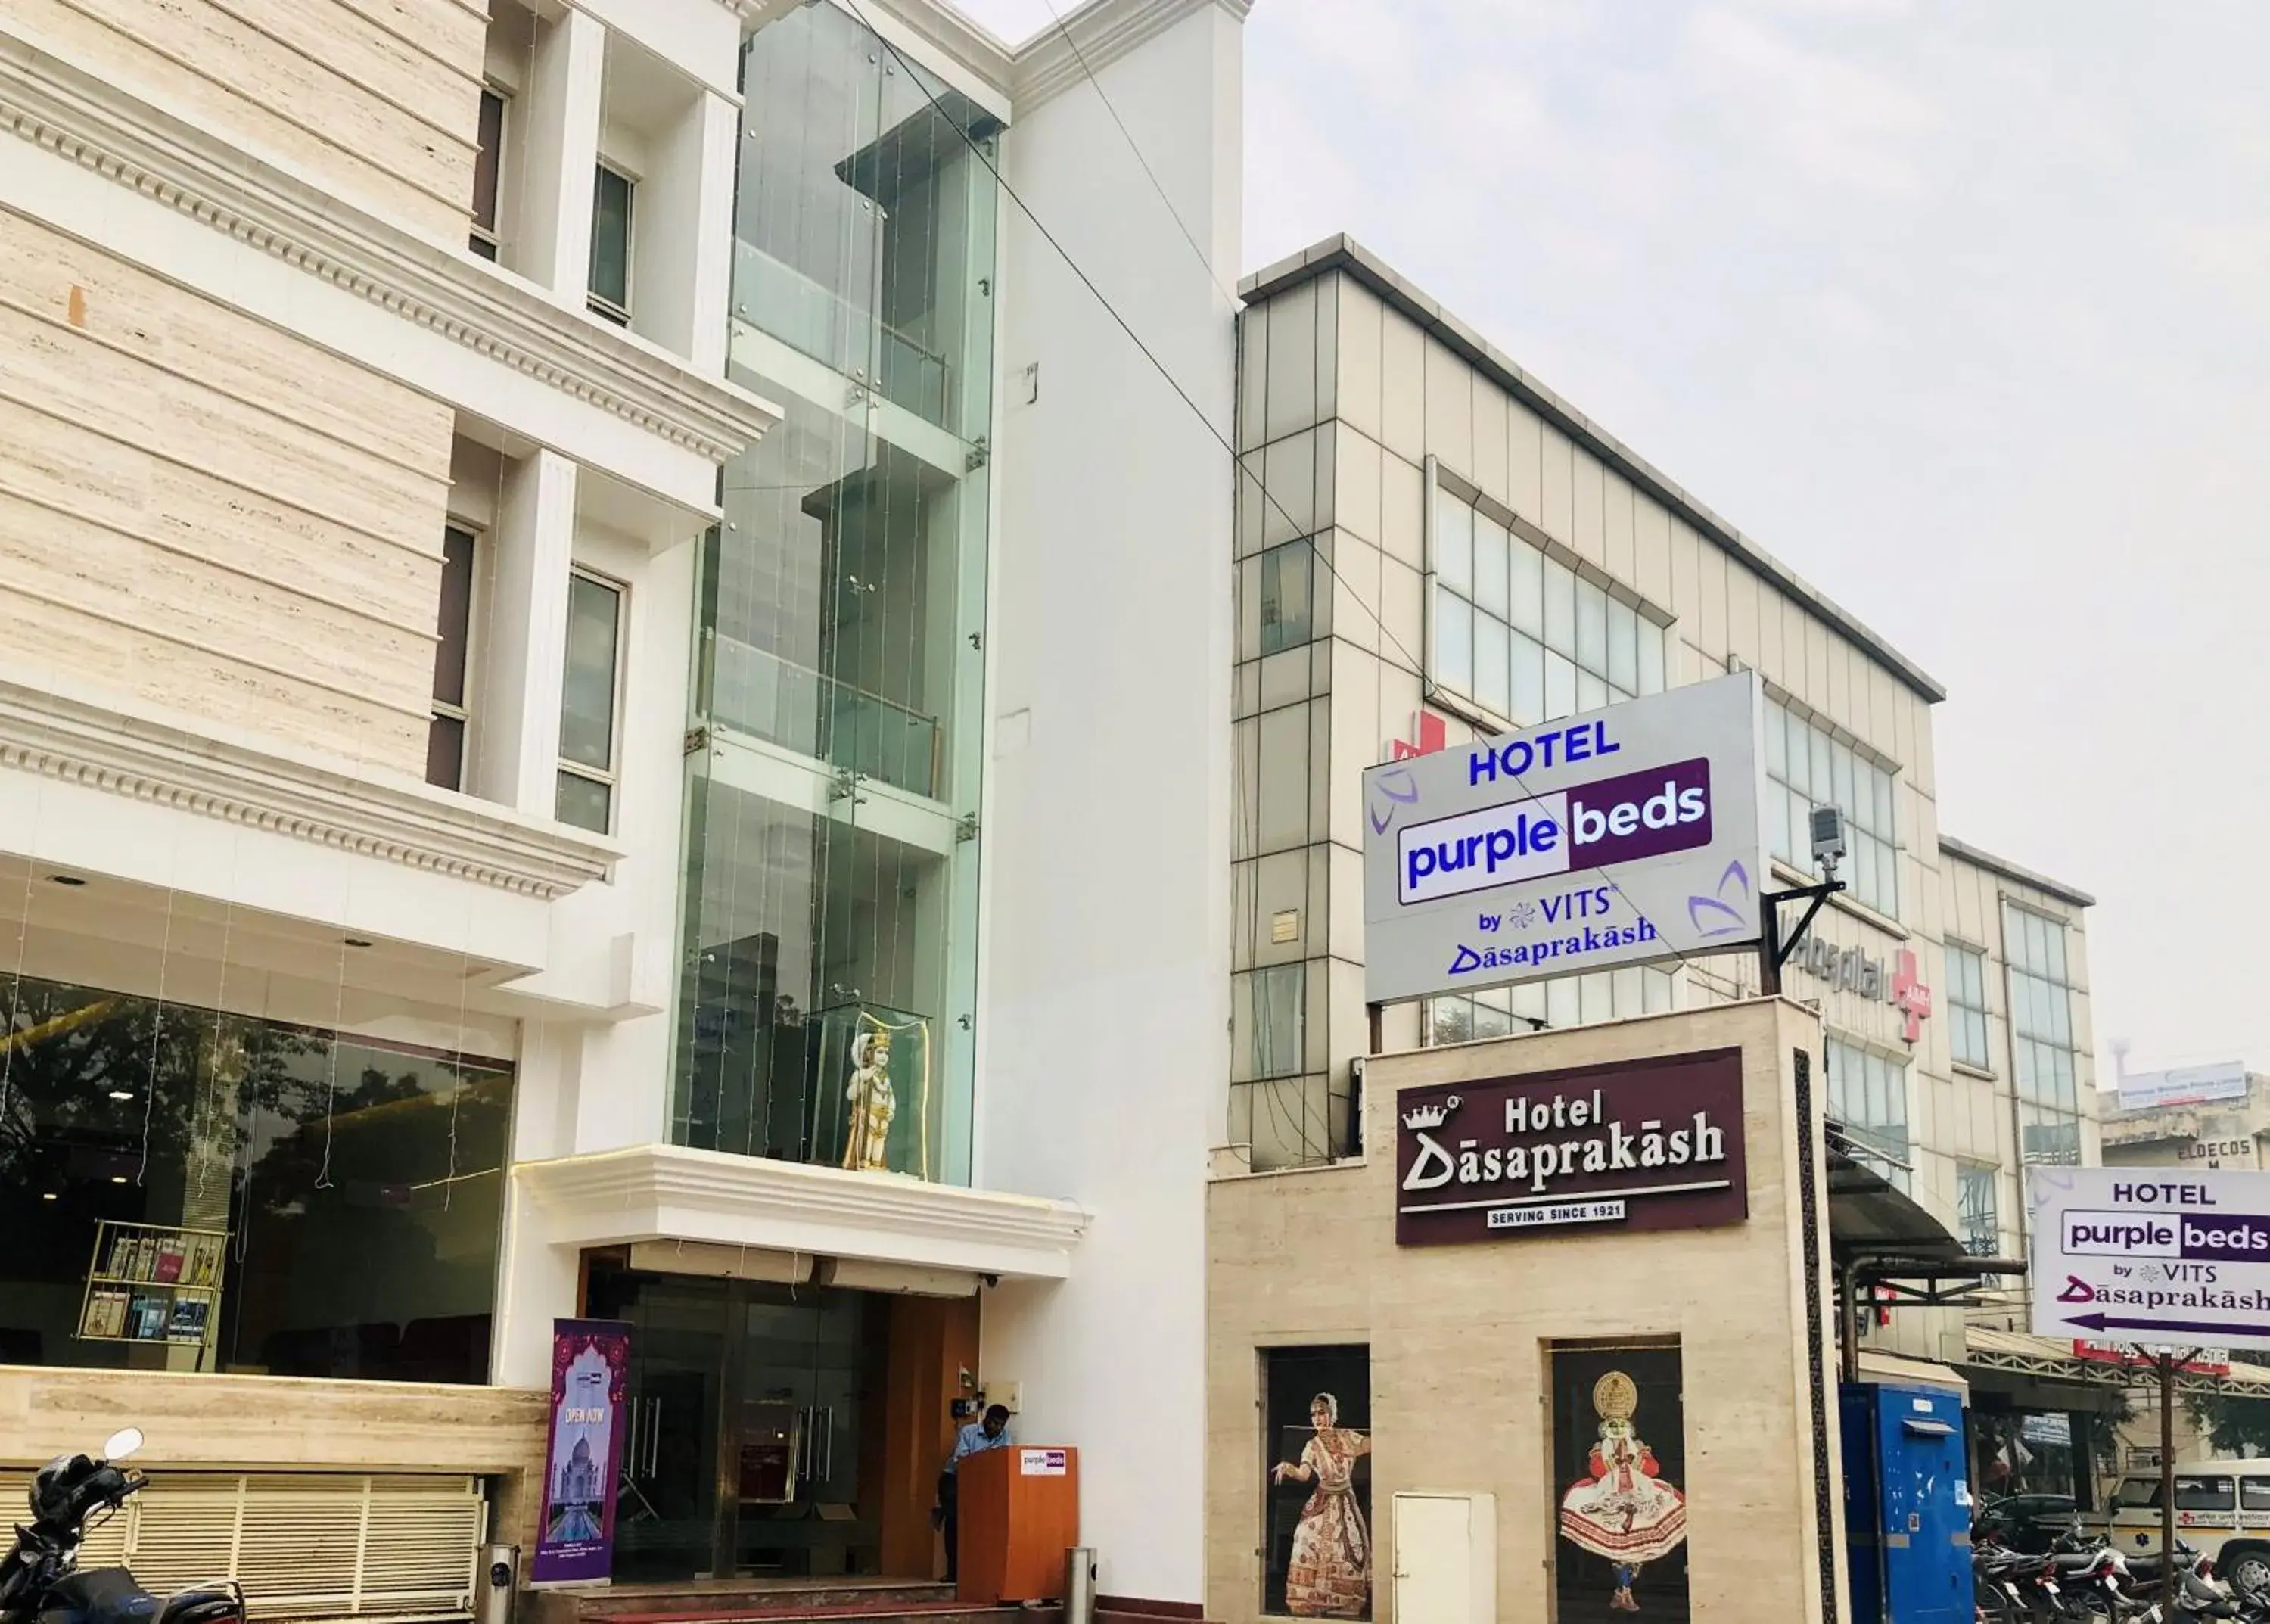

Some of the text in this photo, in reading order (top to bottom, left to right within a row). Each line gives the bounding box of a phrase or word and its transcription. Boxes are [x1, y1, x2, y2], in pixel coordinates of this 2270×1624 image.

[1469, 721, 1620, 786] HOTEL
[1407, 782, 1706, 888] purple beds
[1479, 886, 1610, 932] by VITS
[1448, 916, 1656, 975] Dāsaprakāsh
[1504, 1090, 1602, 1133] Hotel
[1403, 1112, 1724, 1192] Dāsaprakāsh
[1492, 1205, 1620, 1224] SERVING SINCE 1921
[2114, 1184, 2216, 1206] HOTEL
[2071, 1221, 2268, 1249] purple beds
[2113, 1264, 2217, 1283] by VITS
[565, 1408, 586, 1423] OPEN
